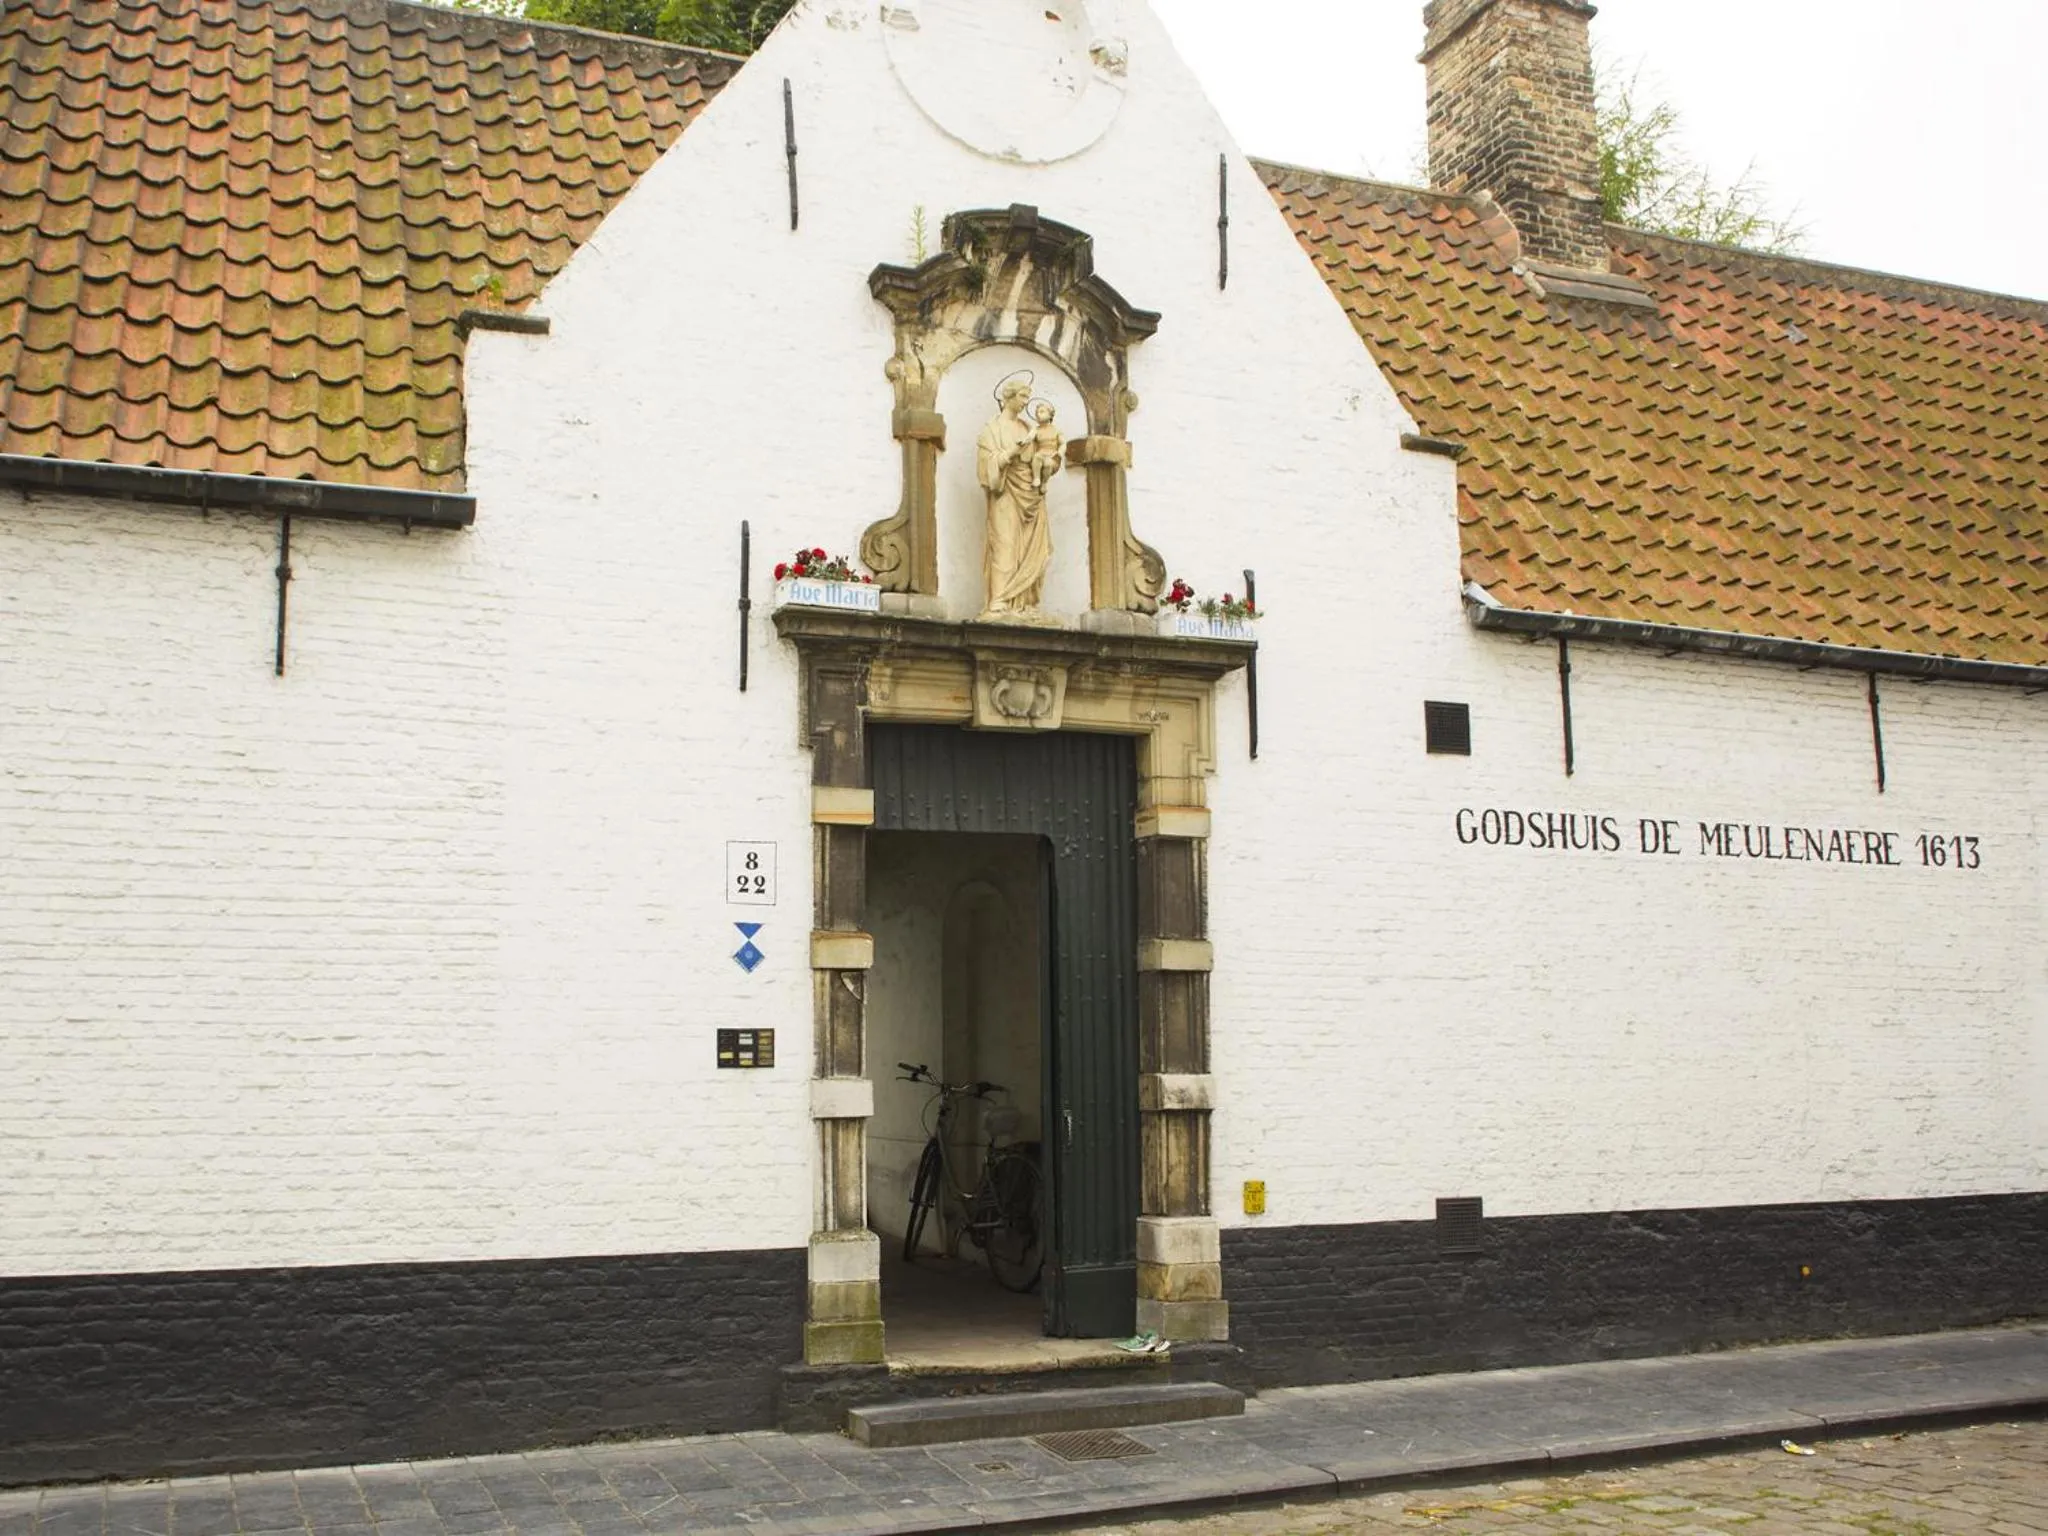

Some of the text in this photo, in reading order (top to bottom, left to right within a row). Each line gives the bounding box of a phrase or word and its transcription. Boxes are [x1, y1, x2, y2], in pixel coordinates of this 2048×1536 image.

[790, 581, 821, 602] Ave
[1455, 808, 1982, 869] GODSHUIS DE MEULENAERE 1613
[745, 851, 759, 870] 8
[736, 875, 766, 894] 22
